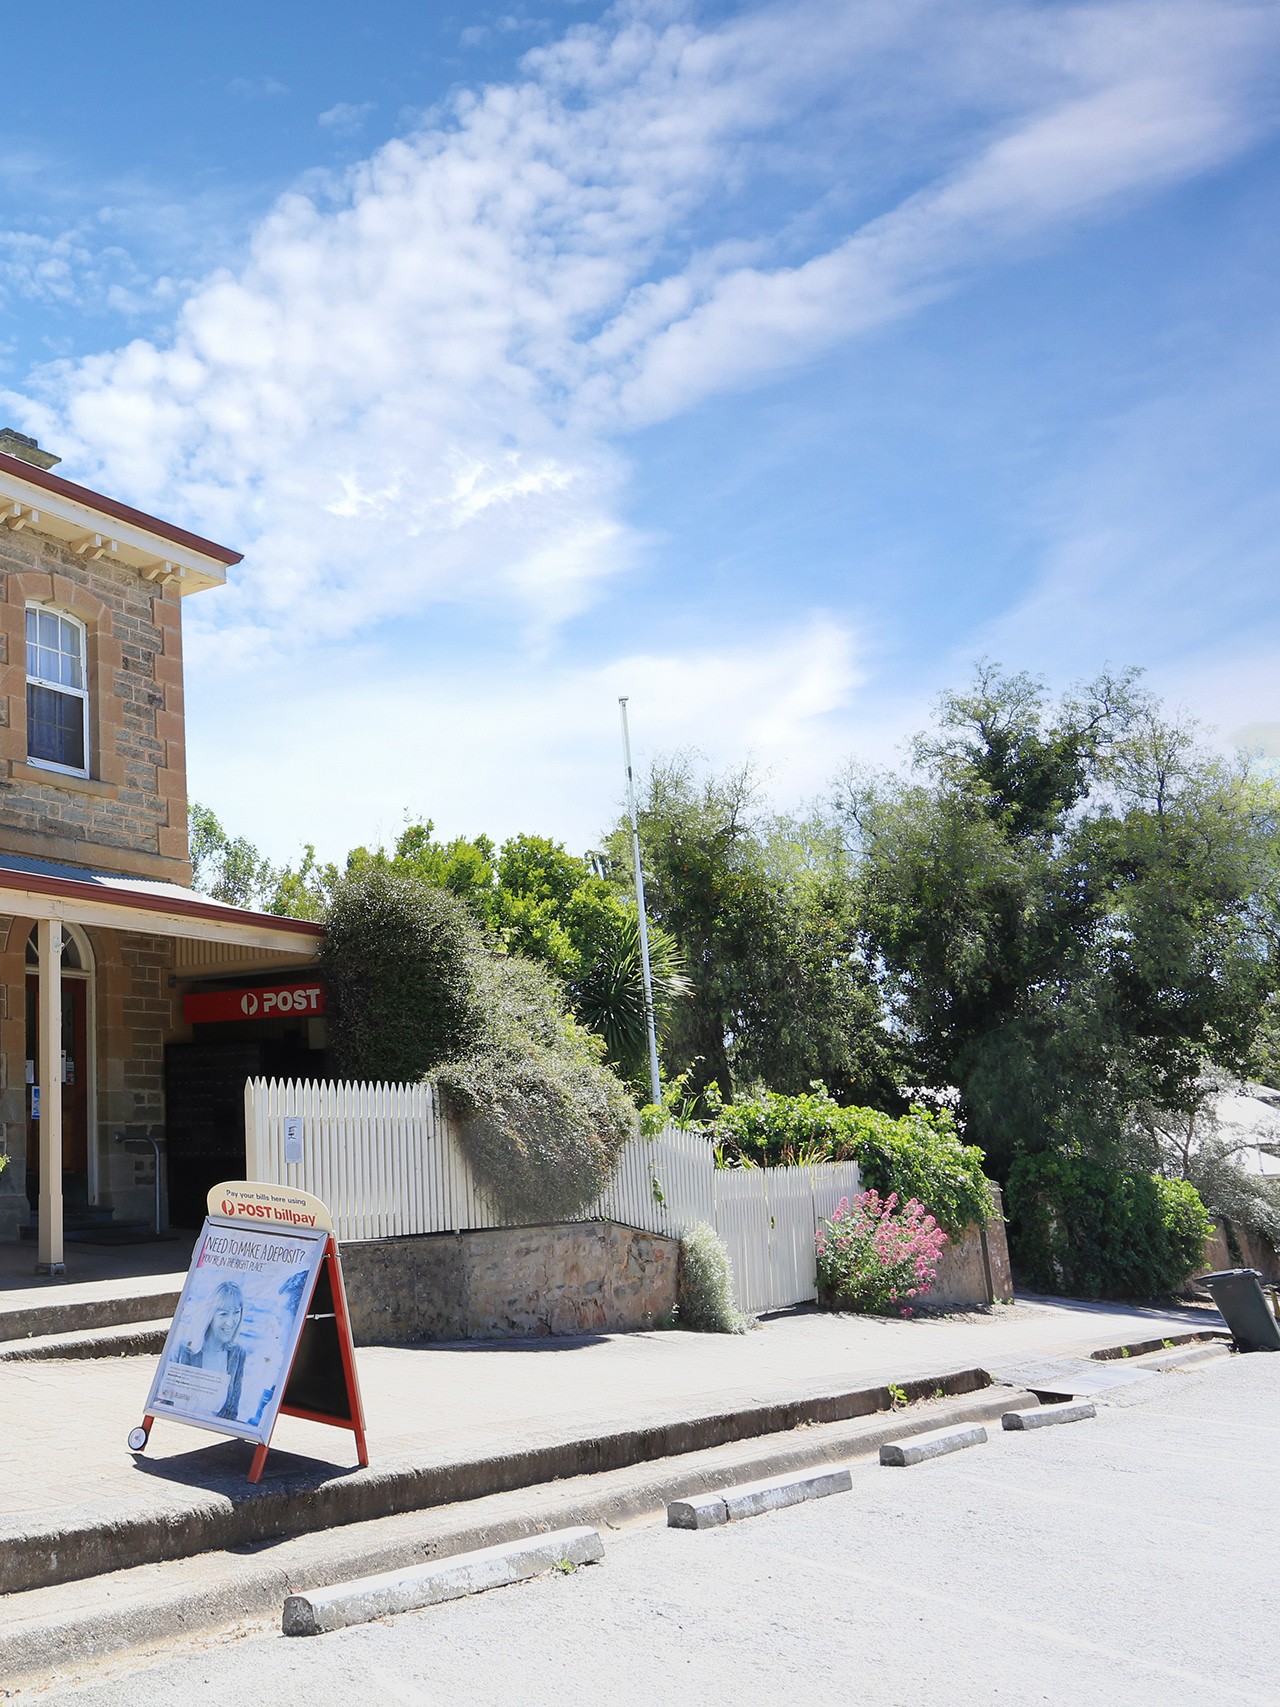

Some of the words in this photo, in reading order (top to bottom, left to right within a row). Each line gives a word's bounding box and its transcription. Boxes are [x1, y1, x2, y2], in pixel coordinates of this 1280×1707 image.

[263, 989, 320, 1013] POST
[239, 1192, 254, 1200] your
[271, 1195, 286, 1203] here
[287, 1198, 306, 1206] using
[237, 1203, 271, 1218] POST
[274, 1207, 316, 1226] billpay
[206, 1236, 228, 1254] NEED
[228, 1239, 239, 1255] TO
[238, 1241, 261, 1259] MAKE
[261, 1244, 268, 1260] A
[268, 1245, 306, 1264] DEPOSIT?
[235, 1259, 249, 1270] RIGHT
